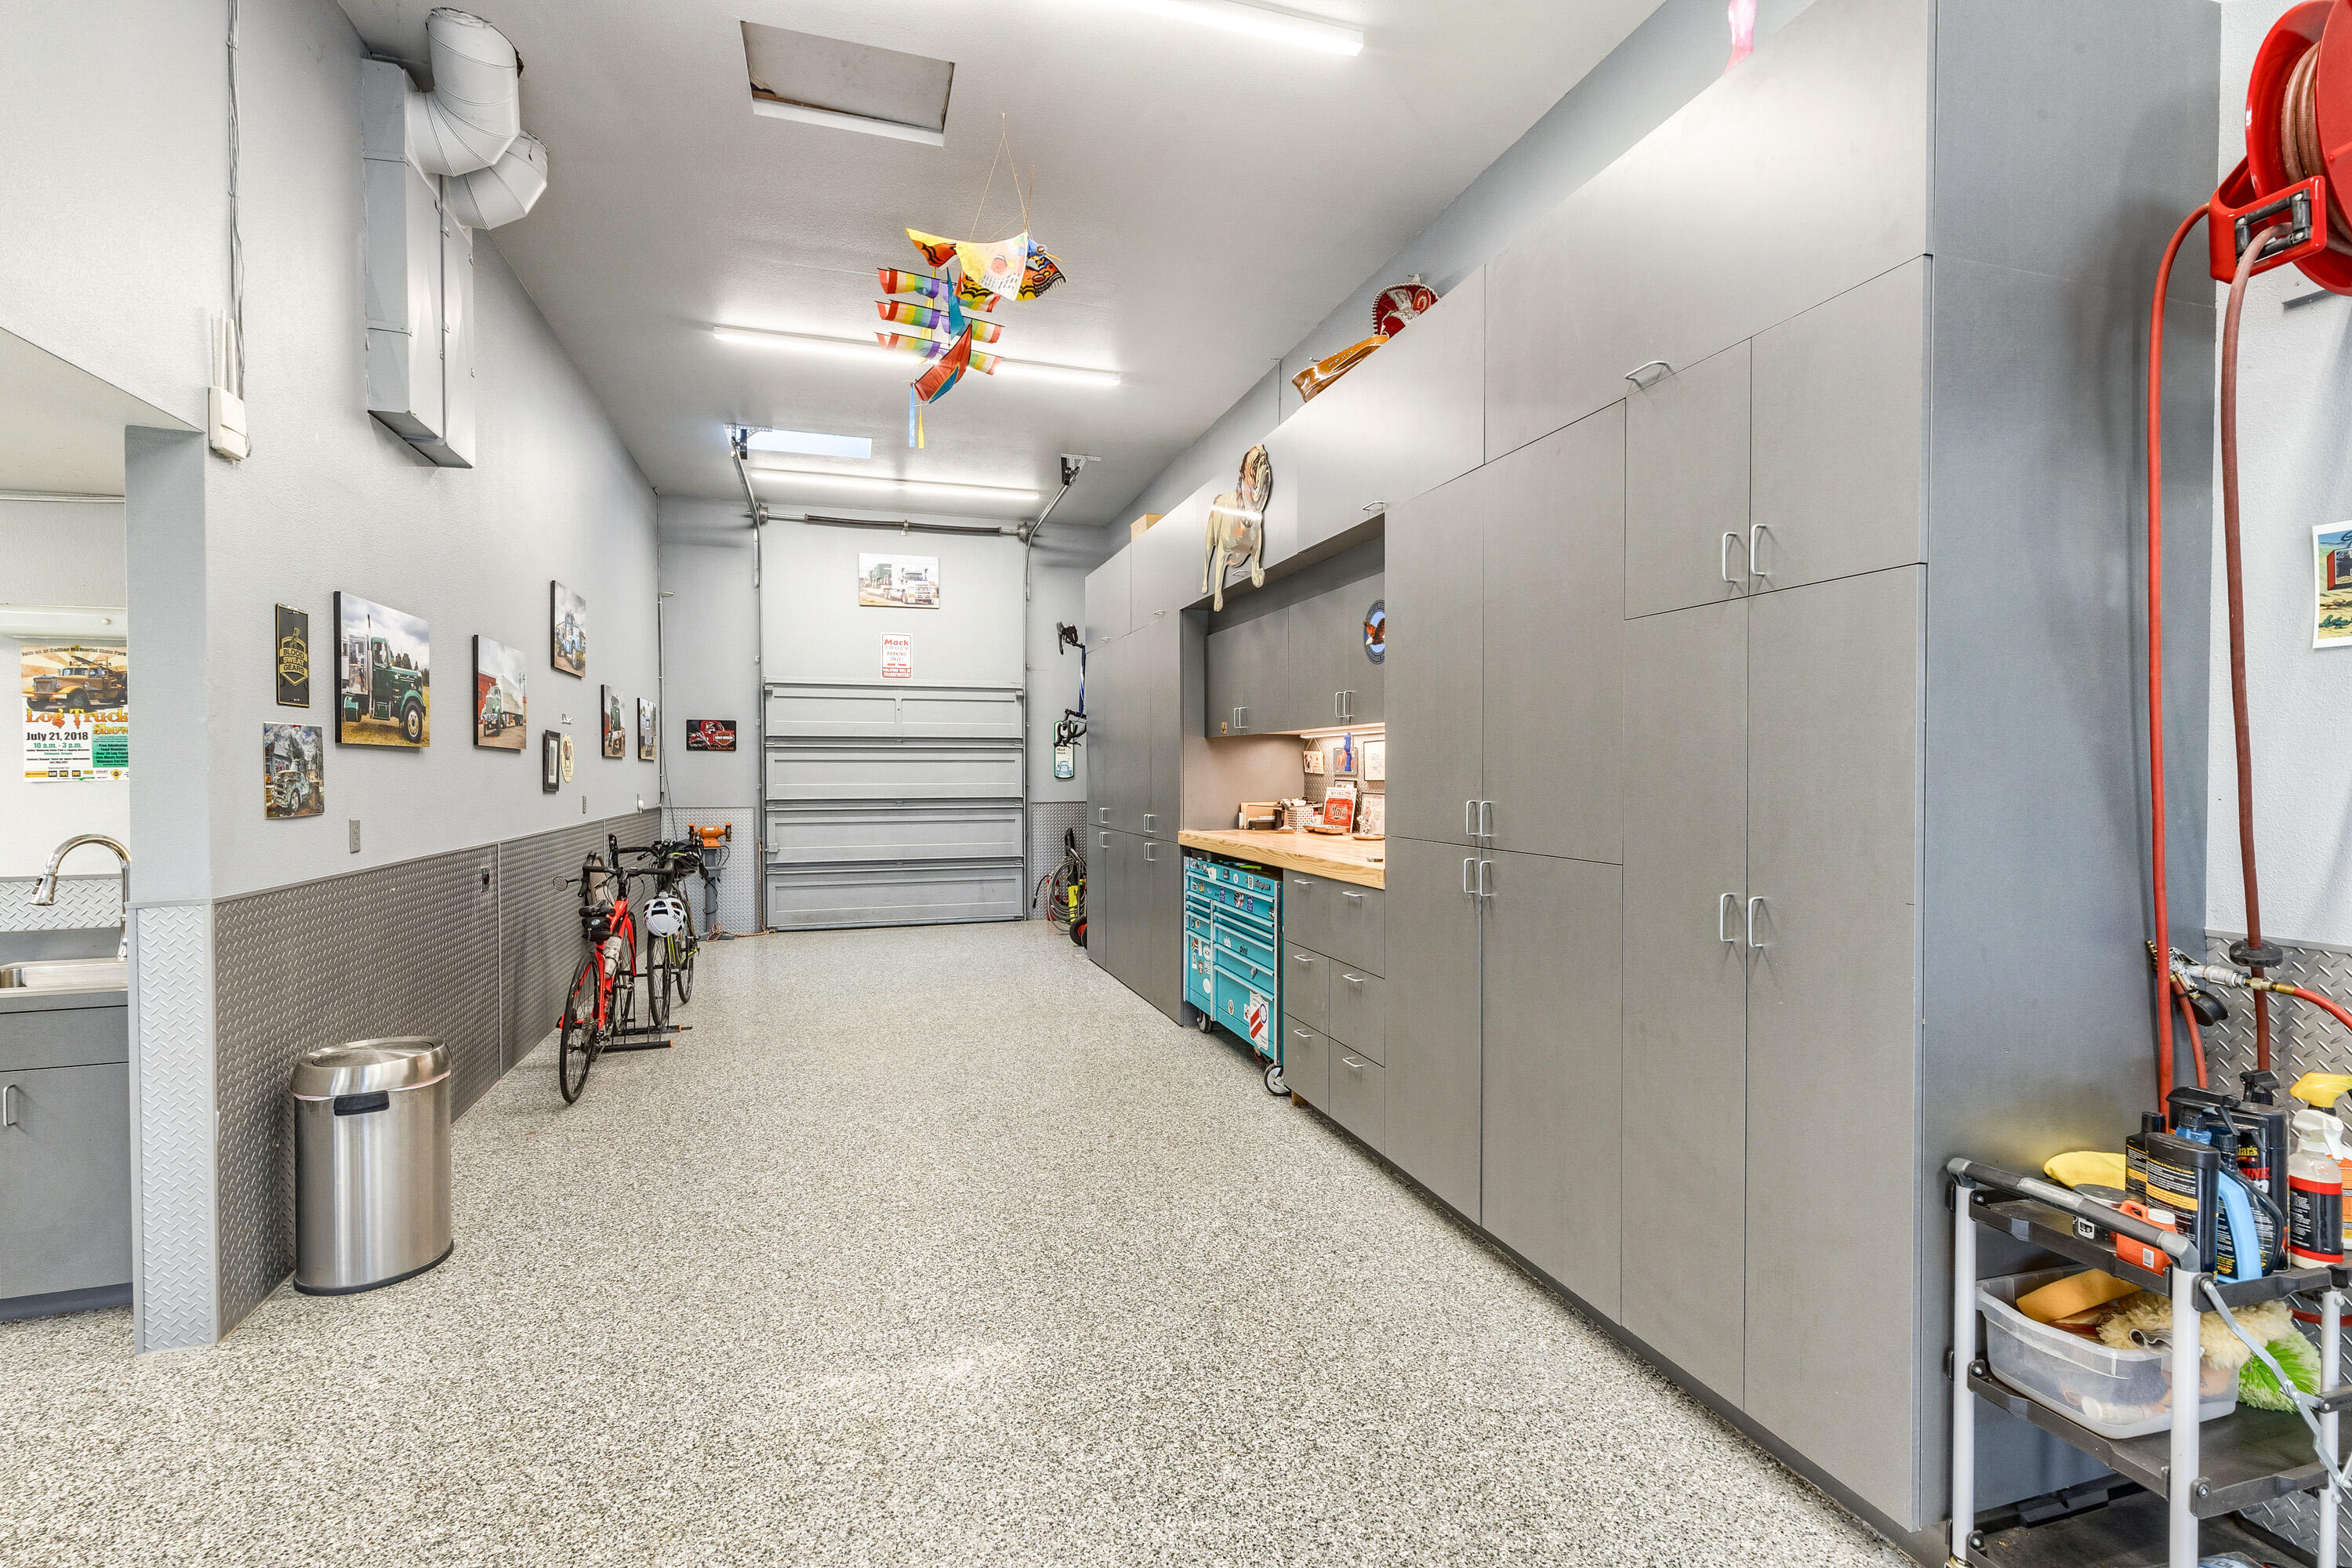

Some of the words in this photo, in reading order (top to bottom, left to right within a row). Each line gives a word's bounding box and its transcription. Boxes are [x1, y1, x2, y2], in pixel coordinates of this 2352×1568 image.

[283, 648, 305, 659] BLOOD
[282, 656, 304, 666] SWEAT
[283, 664, 305, 674] GEARS
[25, 708, 65, 728] Log
[69, 708, 129, 729] Truck
[93, 724, 129, 735] Show
[27, 732, 46, 741] July
[49, 731, 63, 741] 21,
[64, 731, 89, 740] 2018
